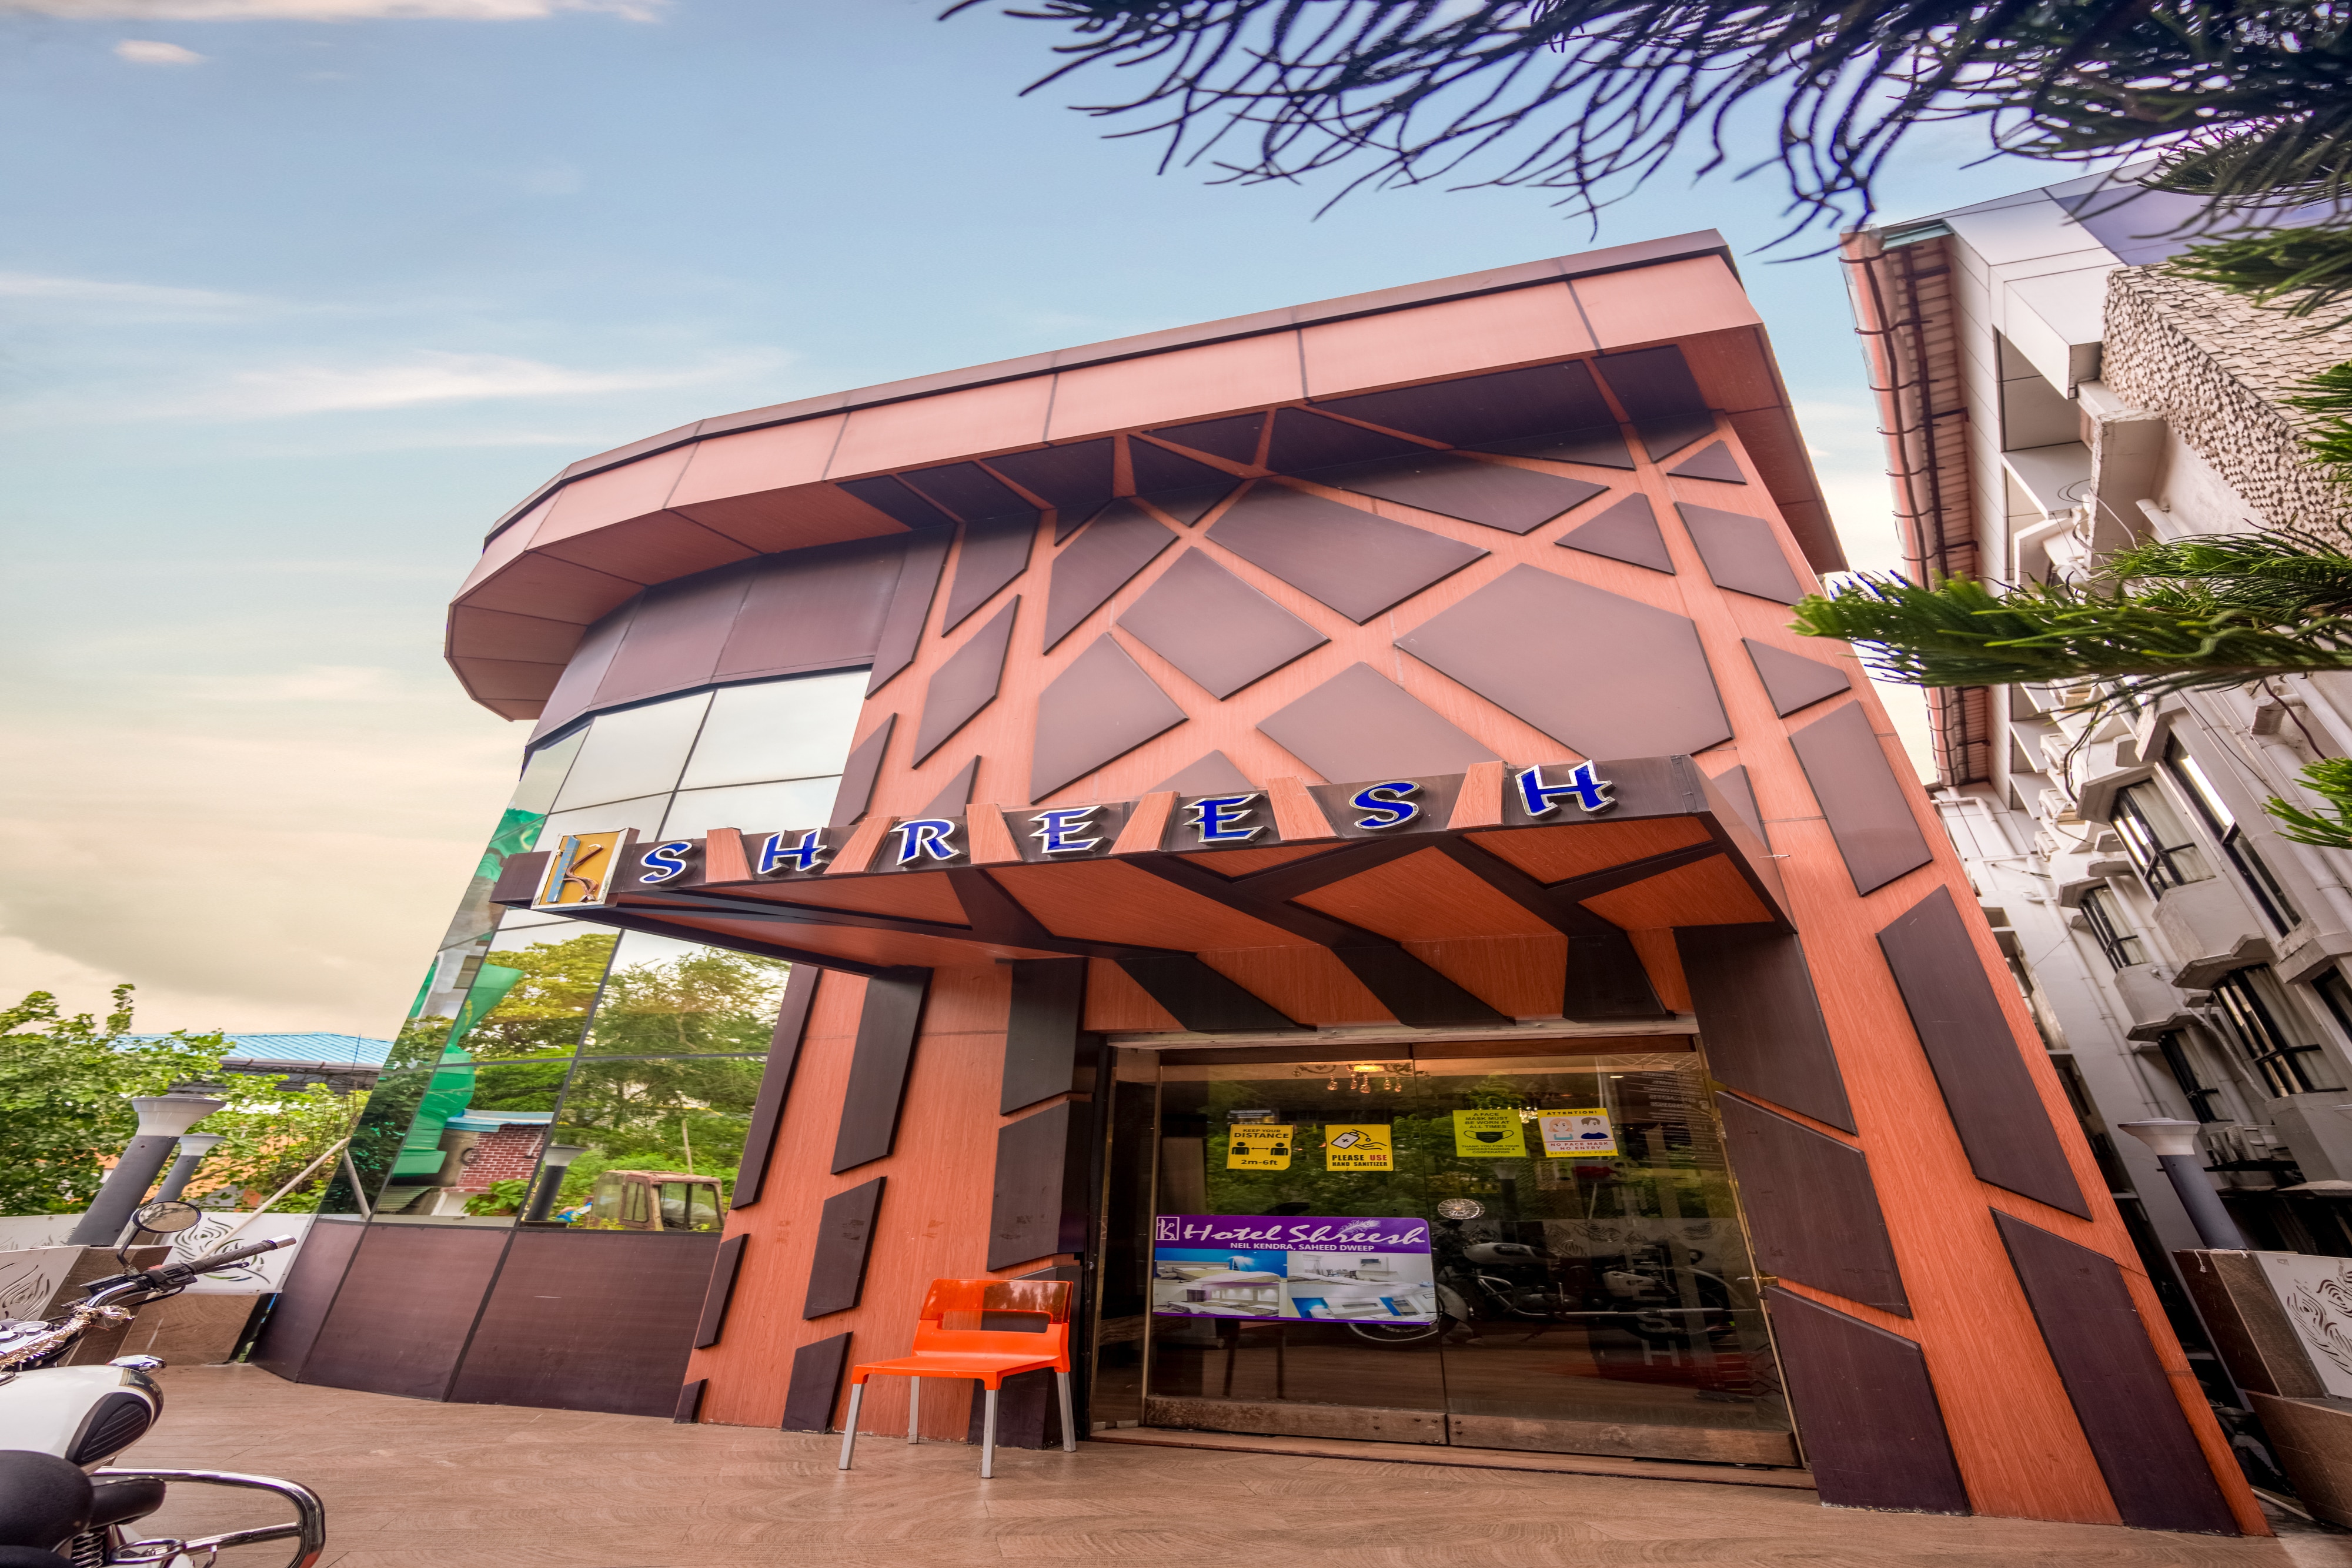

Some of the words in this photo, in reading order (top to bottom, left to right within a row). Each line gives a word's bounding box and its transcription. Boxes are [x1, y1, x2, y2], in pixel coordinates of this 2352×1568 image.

[639, 760, 1616, 883] SHREESH
[1183, 1224, 1282, 1241] Hotel
[1288, 1225, 1425, 1244] Shreesh
